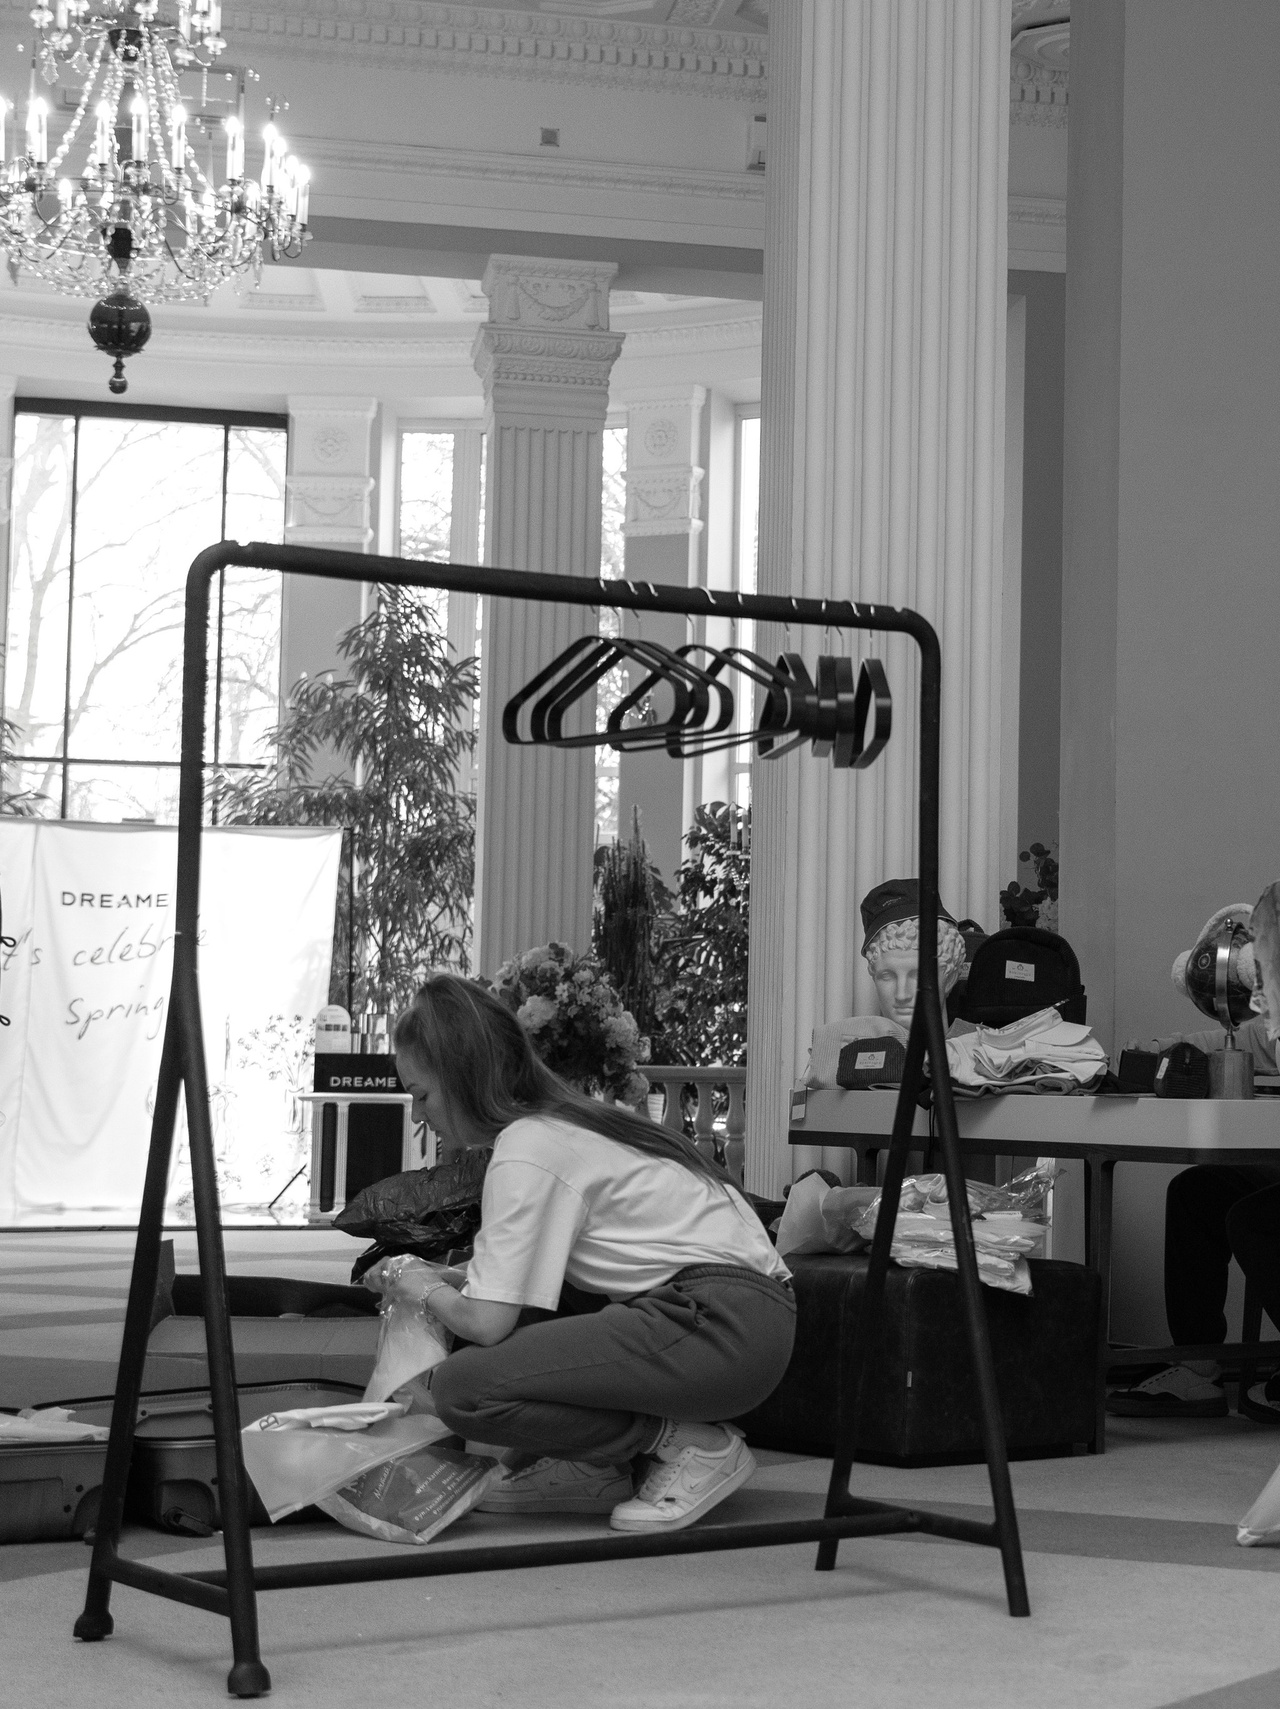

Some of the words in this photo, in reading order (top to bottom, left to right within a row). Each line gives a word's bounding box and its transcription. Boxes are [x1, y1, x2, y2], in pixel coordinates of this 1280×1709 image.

[62, 891, 169, 909] DREAME
[72, 914, 208, 967] celebre
[65, 985, 165, 1041] Spring
[329, 1076, 398, 1088] DREAME
